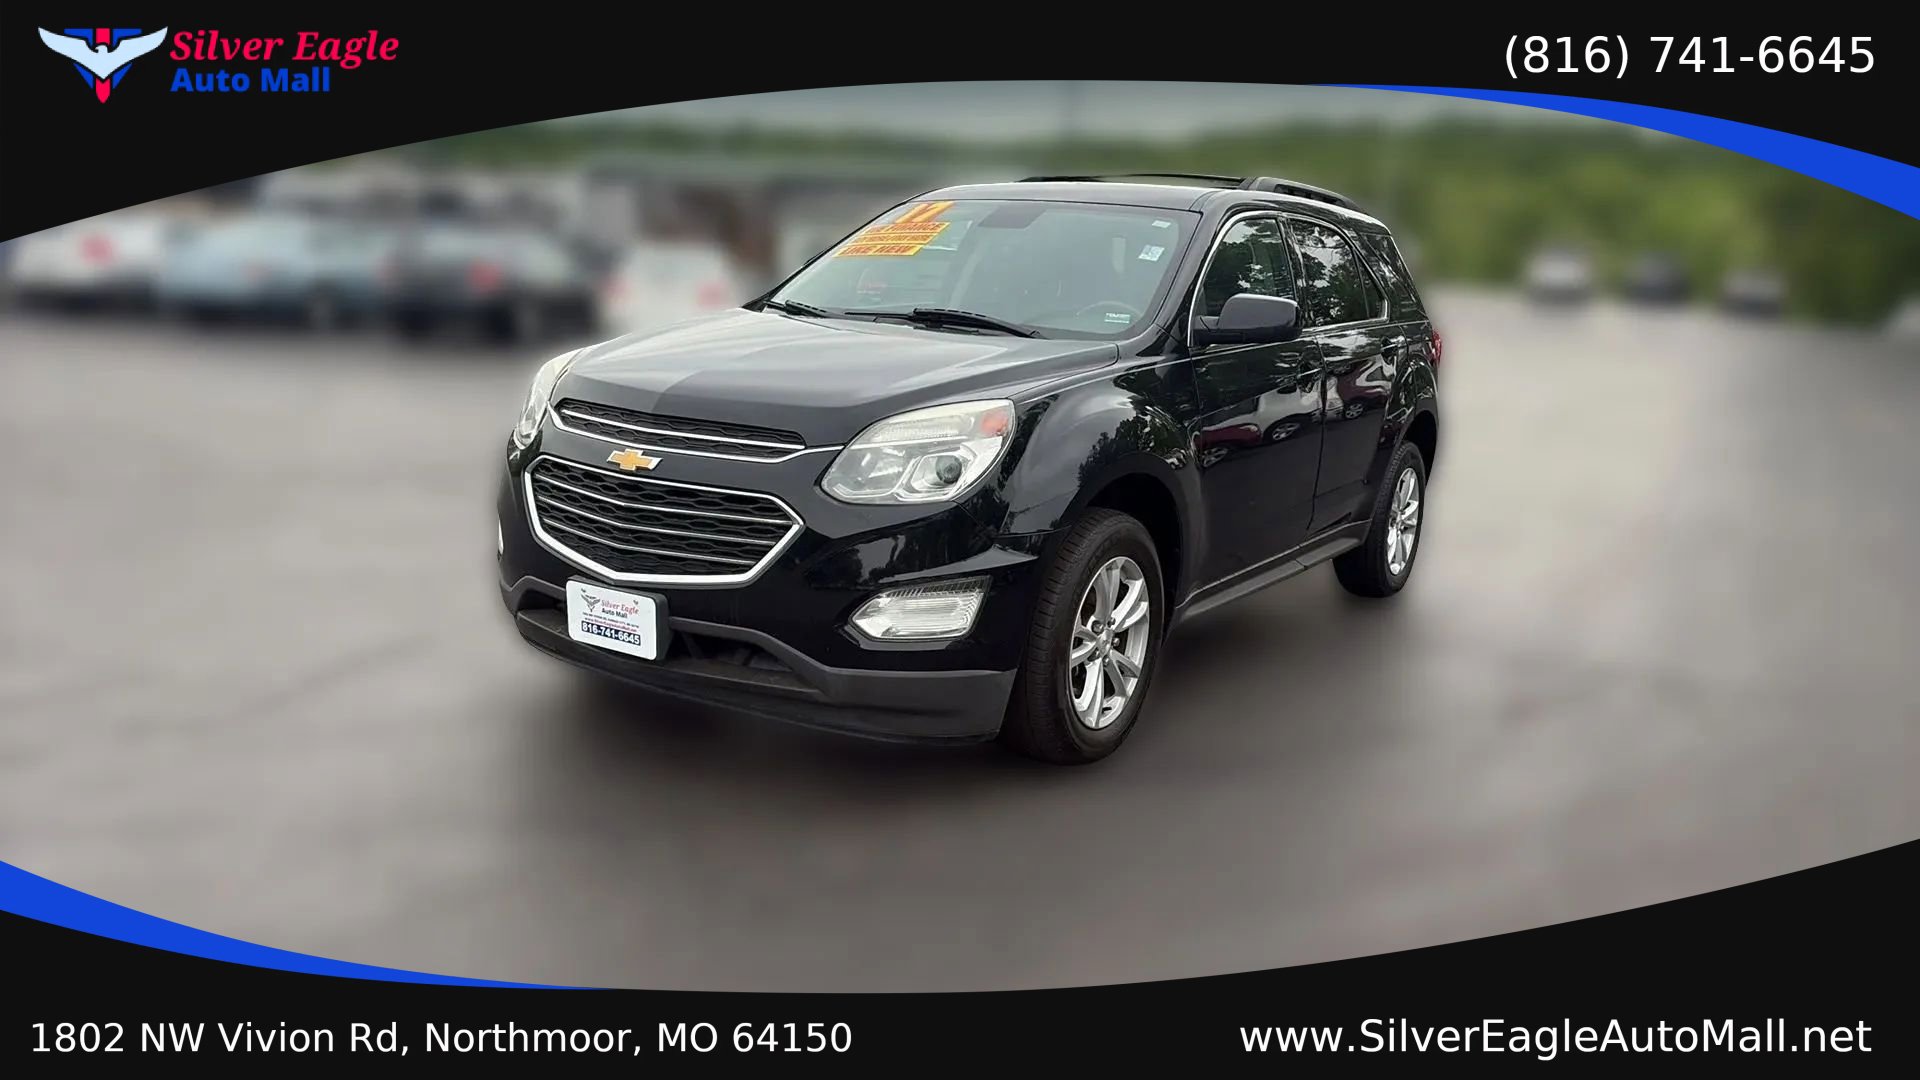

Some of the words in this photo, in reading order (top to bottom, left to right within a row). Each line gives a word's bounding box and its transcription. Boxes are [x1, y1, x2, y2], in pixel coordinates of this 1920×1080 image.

[873, 245, 918, 255] NEW
[601, 599, 620, 610] Silver
[620, 602, 639, 615] Eagle
[601, 607, 615, 616] Auto
[615, 610, 628, 619] Mall
[582, 622, 640, 645] 816-741-6645
